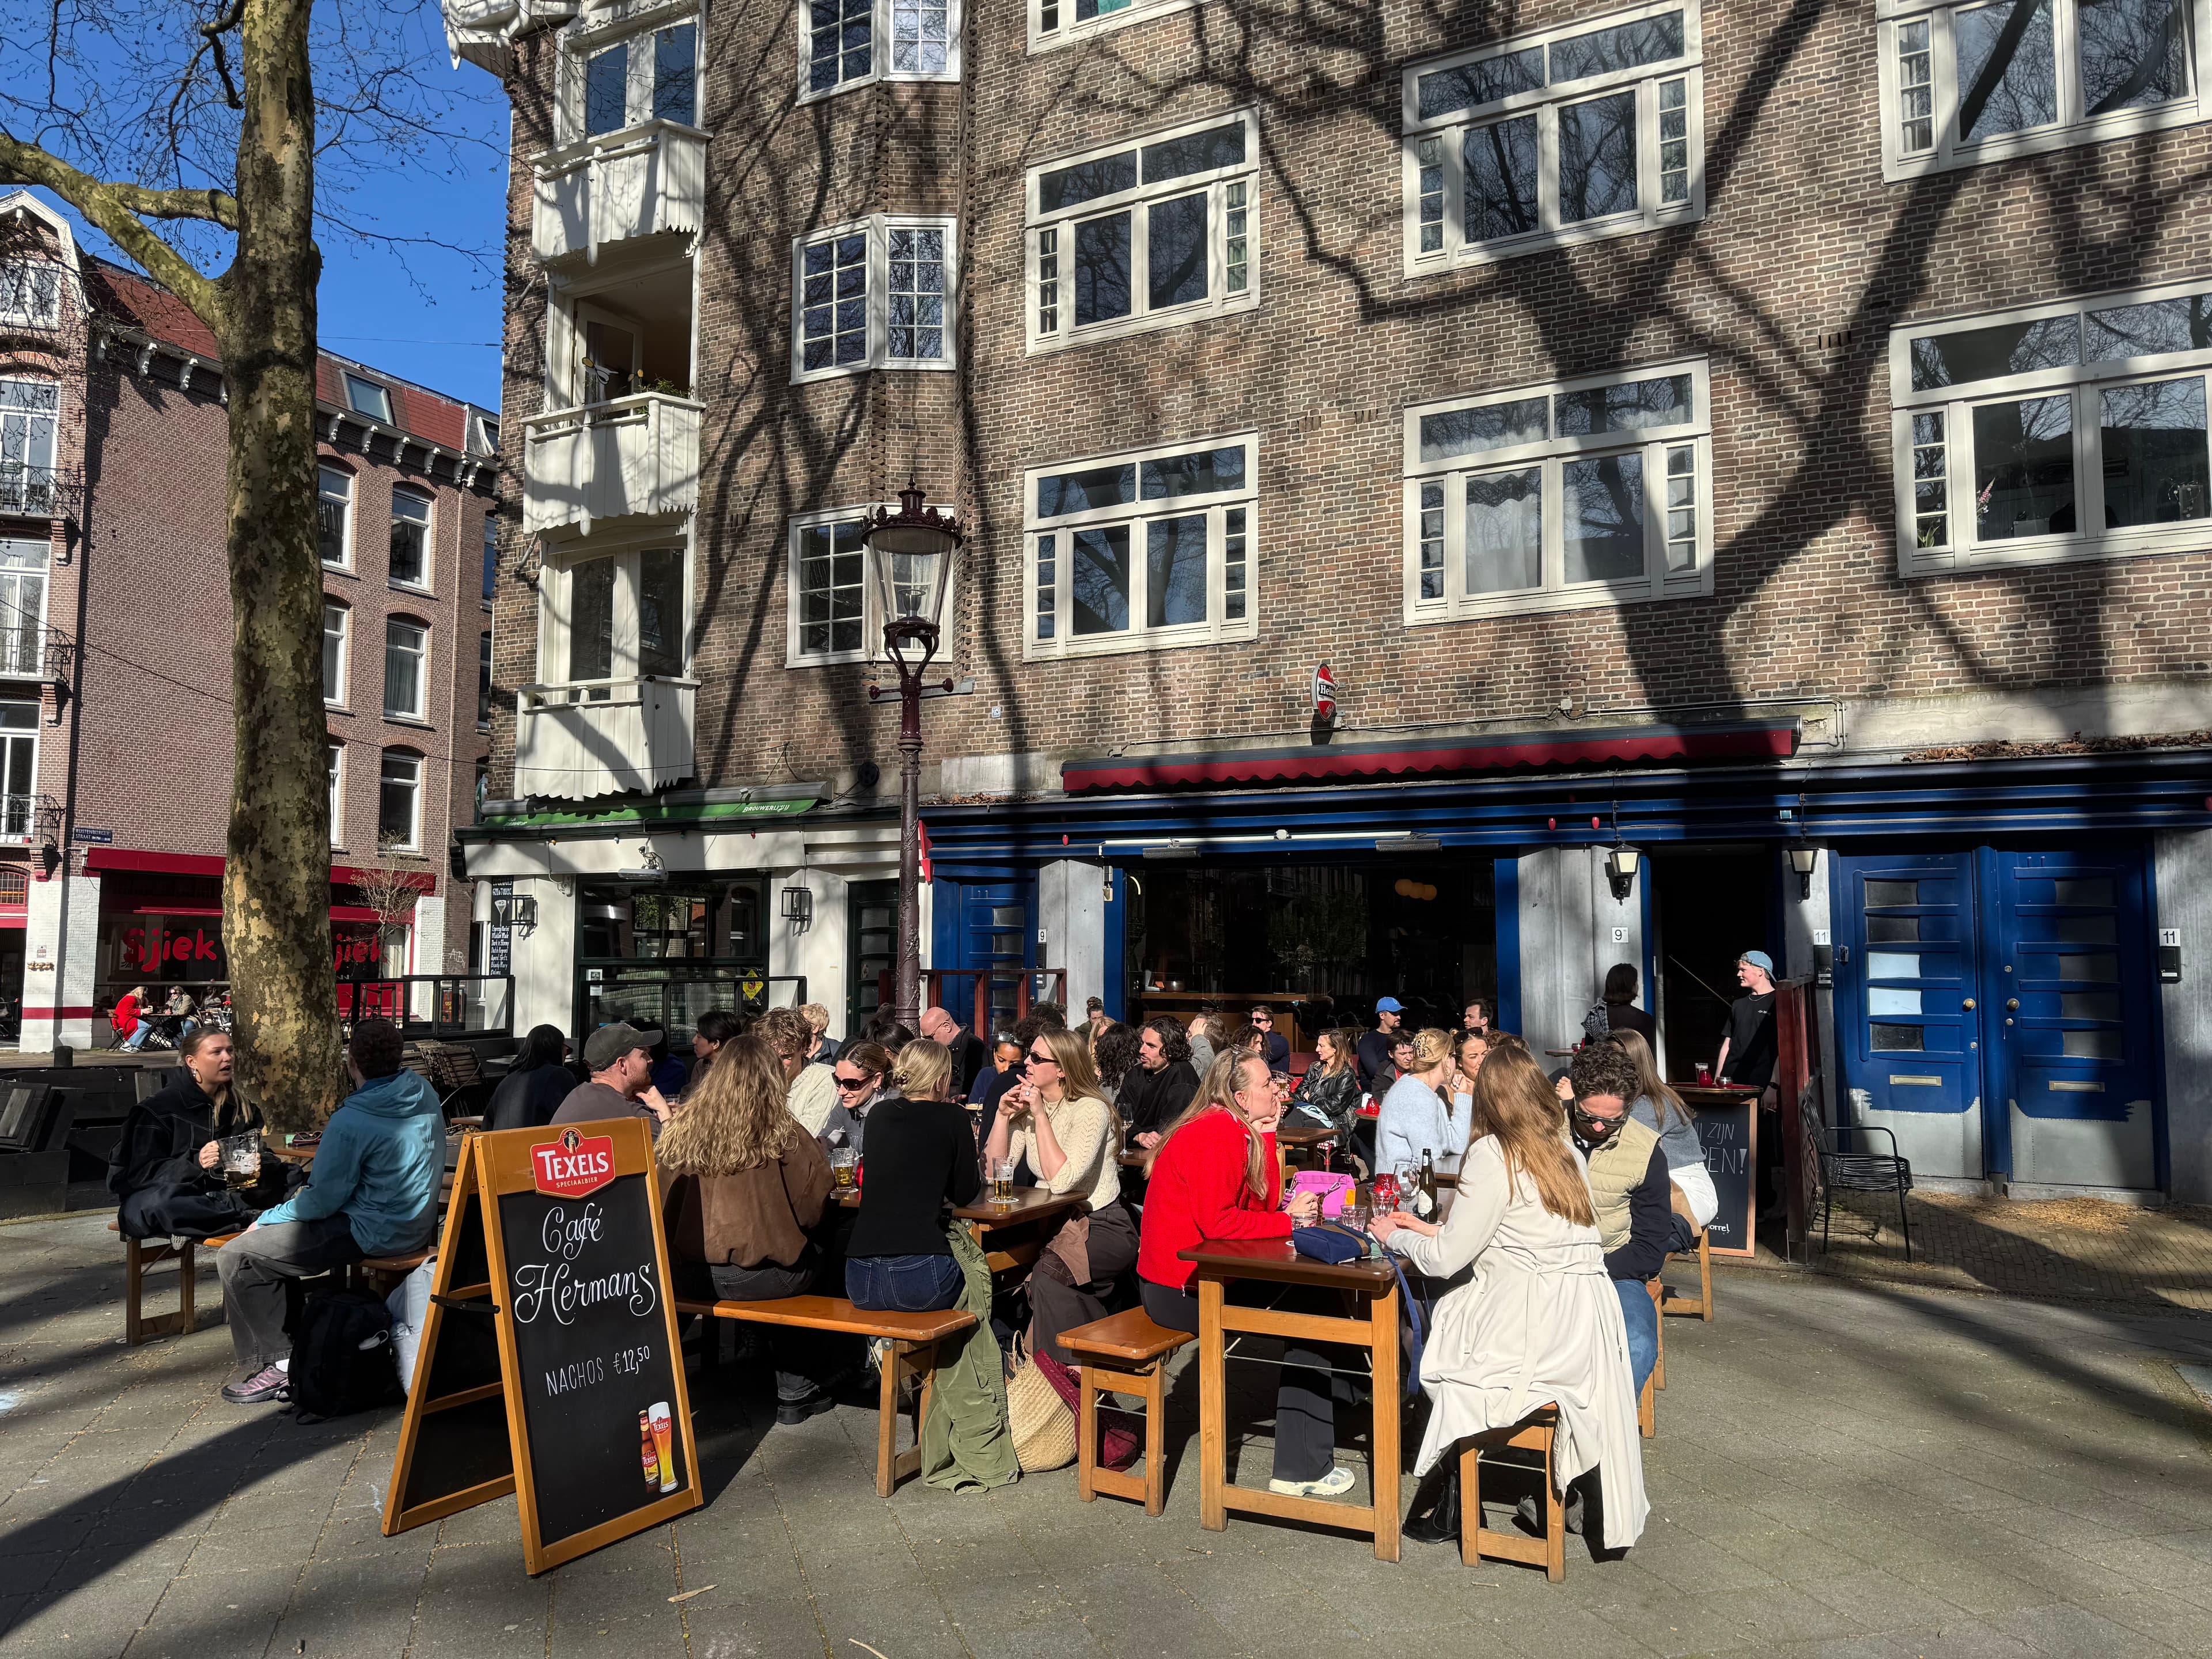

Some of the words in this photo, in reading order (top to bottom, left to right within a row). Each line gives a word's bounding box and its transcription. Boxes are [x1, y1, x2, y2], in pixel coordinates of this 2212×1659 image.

[742, 805, 779, 813] BROUWERIJ
[1040, 931, 1044, 941] 9
[1615, 929, 1622, 941] 9
[1815, 931, 1825, 943] 11
[2163, 930, 2175, 944] 11
[123, 928, 217, 972] Sjiek
[1707, 1123, 1734, 1145] ZIJN
[537, 1150, 609, 1181] TEXELS
[556, 1177, 598, 1188] SPECIAALBIER
[542, 1202, 604, 1260] Café
[546, 1357, 604, 1397] NACHOS
[613, 1345, 650, 1375] €12,50
[652, 1421, 669, 1432] TEXELS
[642, 1455, 657, 1465] TEXELS
